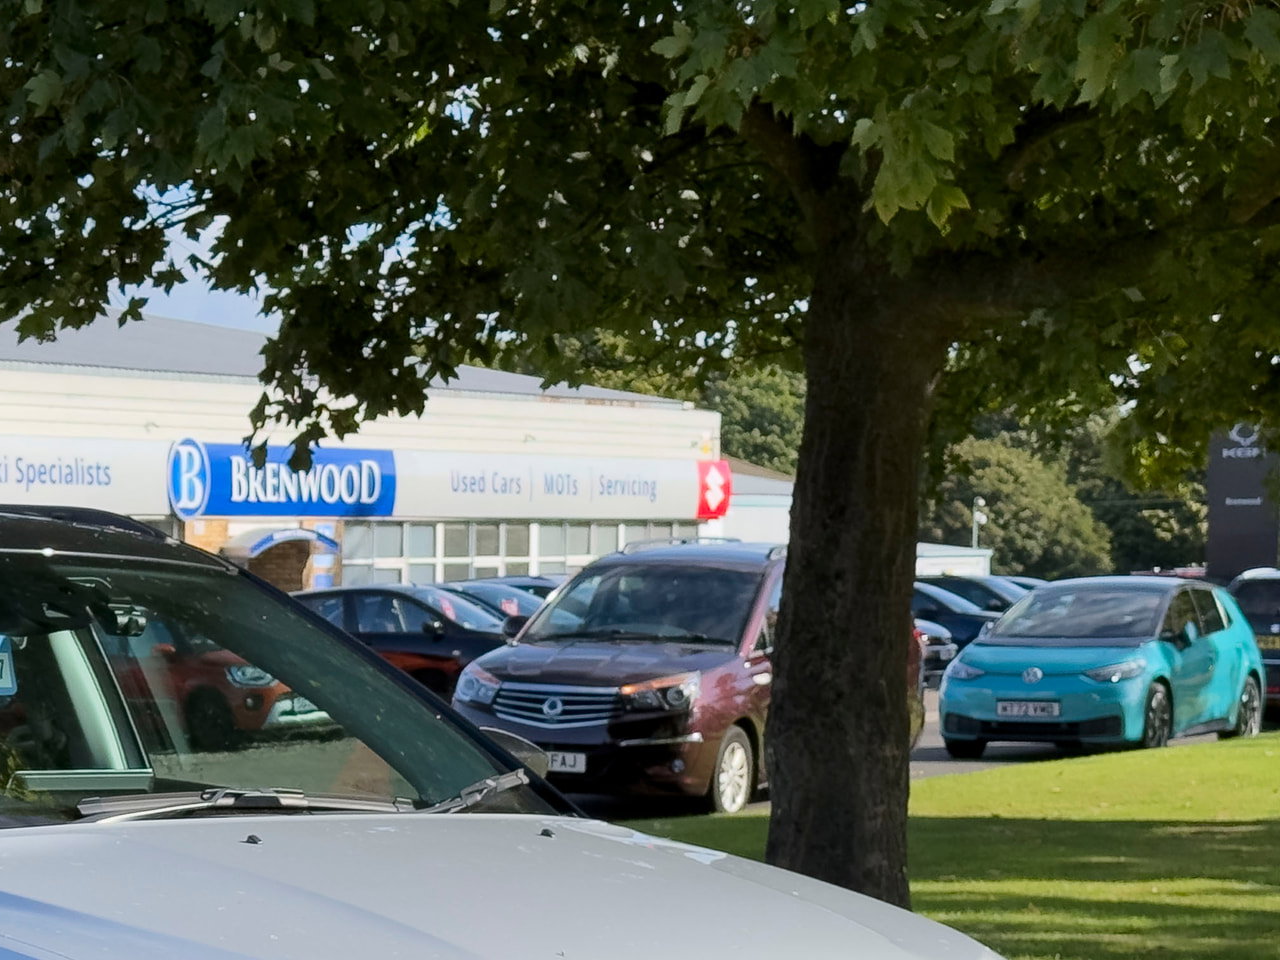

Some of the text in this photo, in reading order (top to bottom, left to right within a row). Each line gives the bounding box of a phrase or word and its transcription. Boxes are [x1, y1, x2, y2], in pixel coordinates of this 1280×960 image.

[16, 457, 112, 492] Specialists
[176, 445, 382, 509] B BRENWOOD
[450, 469, 657, 502] Used Cars MOTs Servicing
